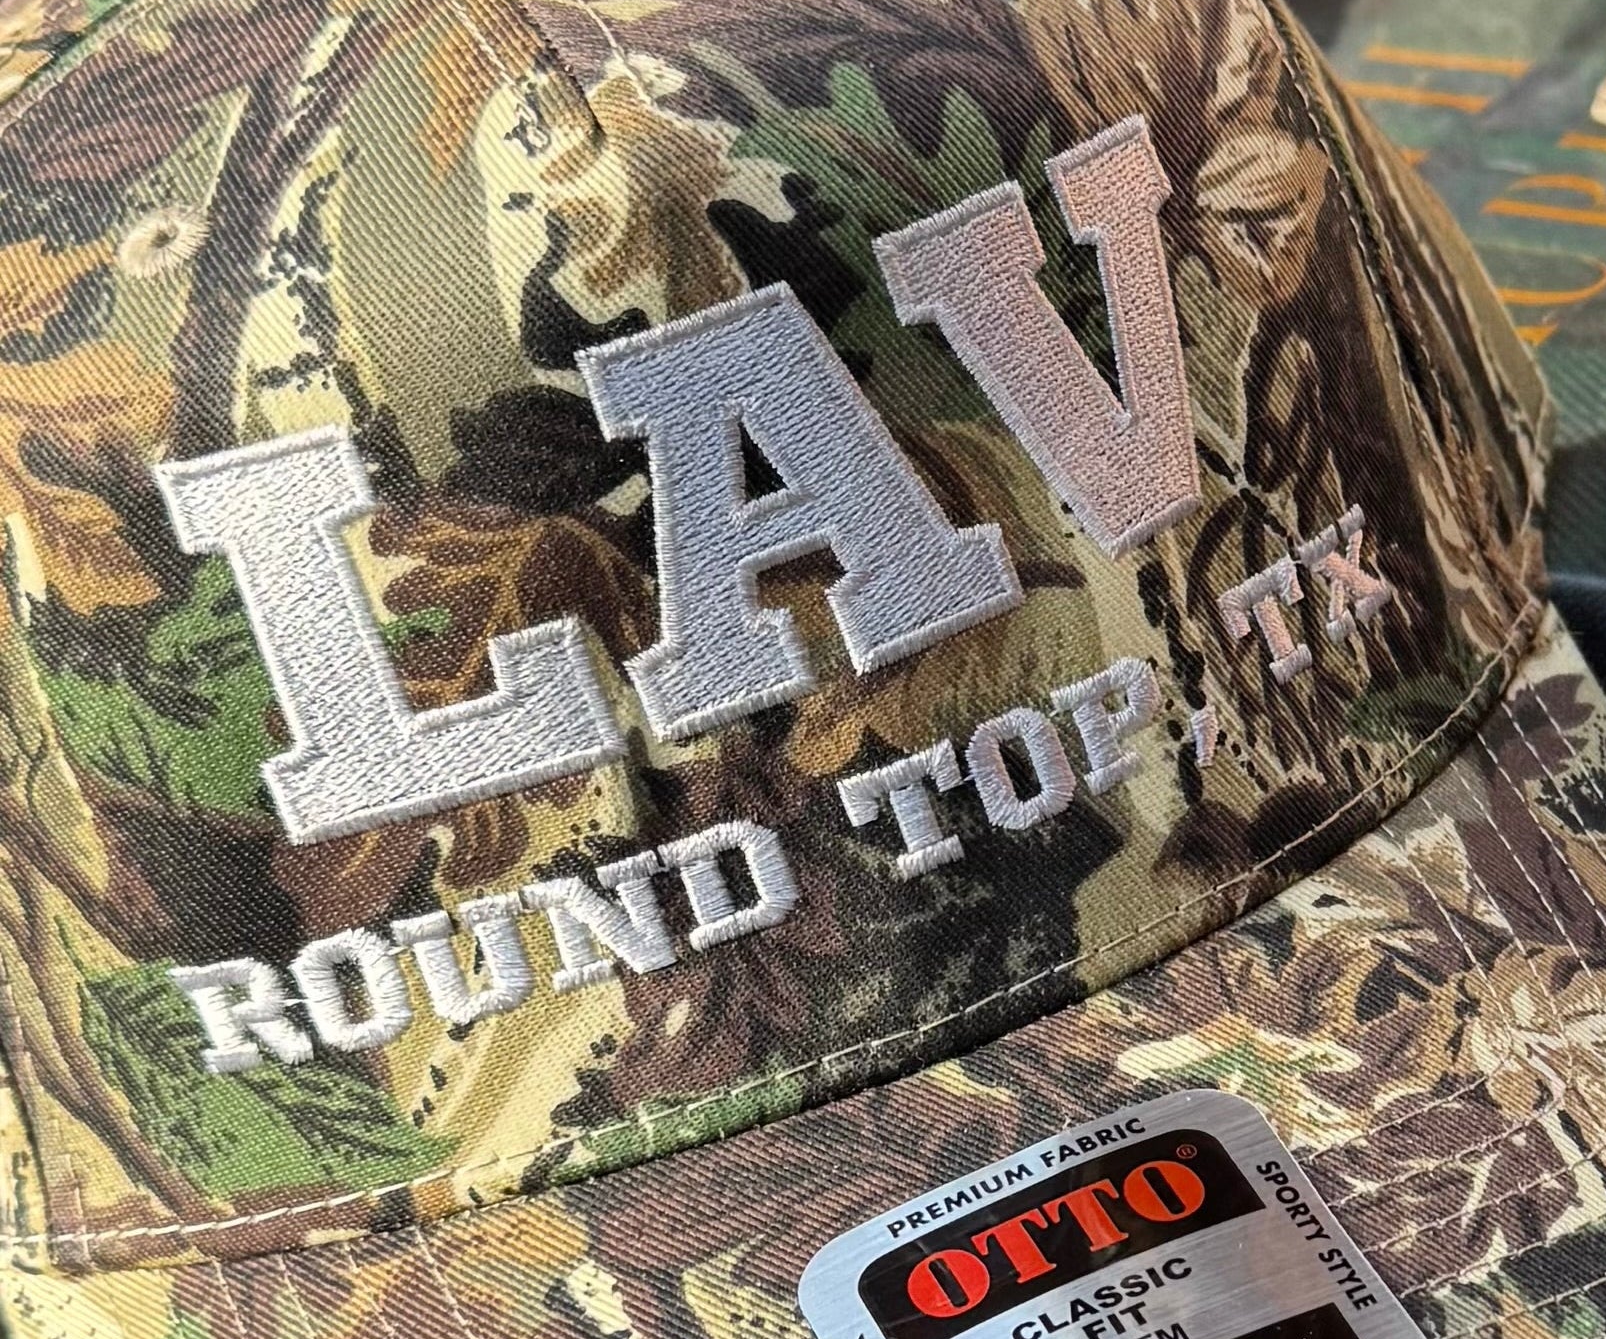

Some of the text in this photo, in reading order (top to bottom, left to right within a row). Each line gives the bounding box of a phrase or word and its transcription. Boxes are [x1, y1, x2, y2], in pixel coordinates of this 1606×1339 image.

[155, 114, 1201, 845] LAV
[169, 502, 1392, 1075] ROUND TOP, TX
[886, 1116, 1148, 1239] PREMIUM FABRIC
[1256, 1161, 1378, 1311] SPORTY STYLE
